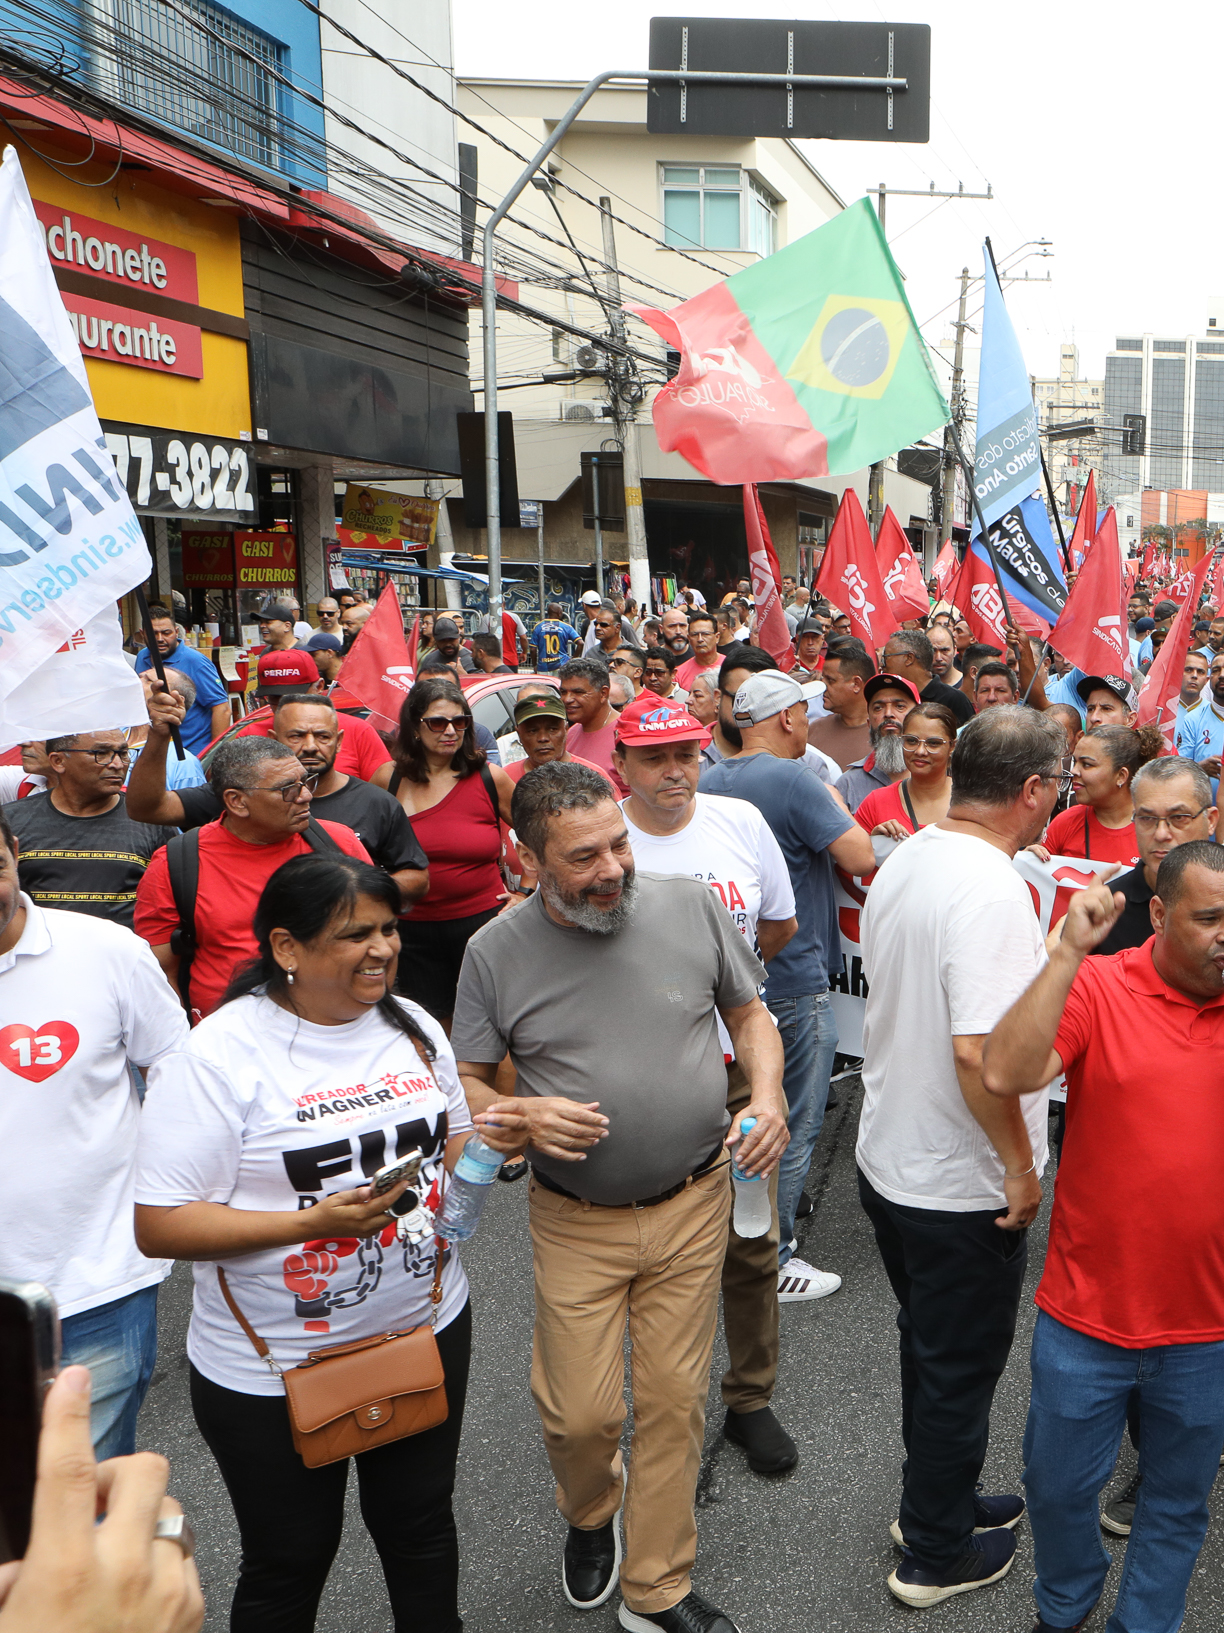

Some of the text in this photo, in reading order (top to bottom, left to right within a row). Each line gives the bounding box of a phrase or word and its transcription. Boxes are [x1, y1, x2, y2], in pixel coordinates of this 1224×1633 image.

[355, 522, 391, 534] RECHEADOS
[188, 536, 229, 548] GASI
[242, 541, 274, 557] GASI
[185, 573, 234, 582] CHURROS
[240, 567, 296, 582] CHURROS
[544, 634, 560, 655] 10
[1092, 627, 1123, 656] SINDICATO
[264, 668, 300, 678] PERIFA
[9, 1035, 63, 1067] 13
[333, 1113, 364, 1126] Sempre
